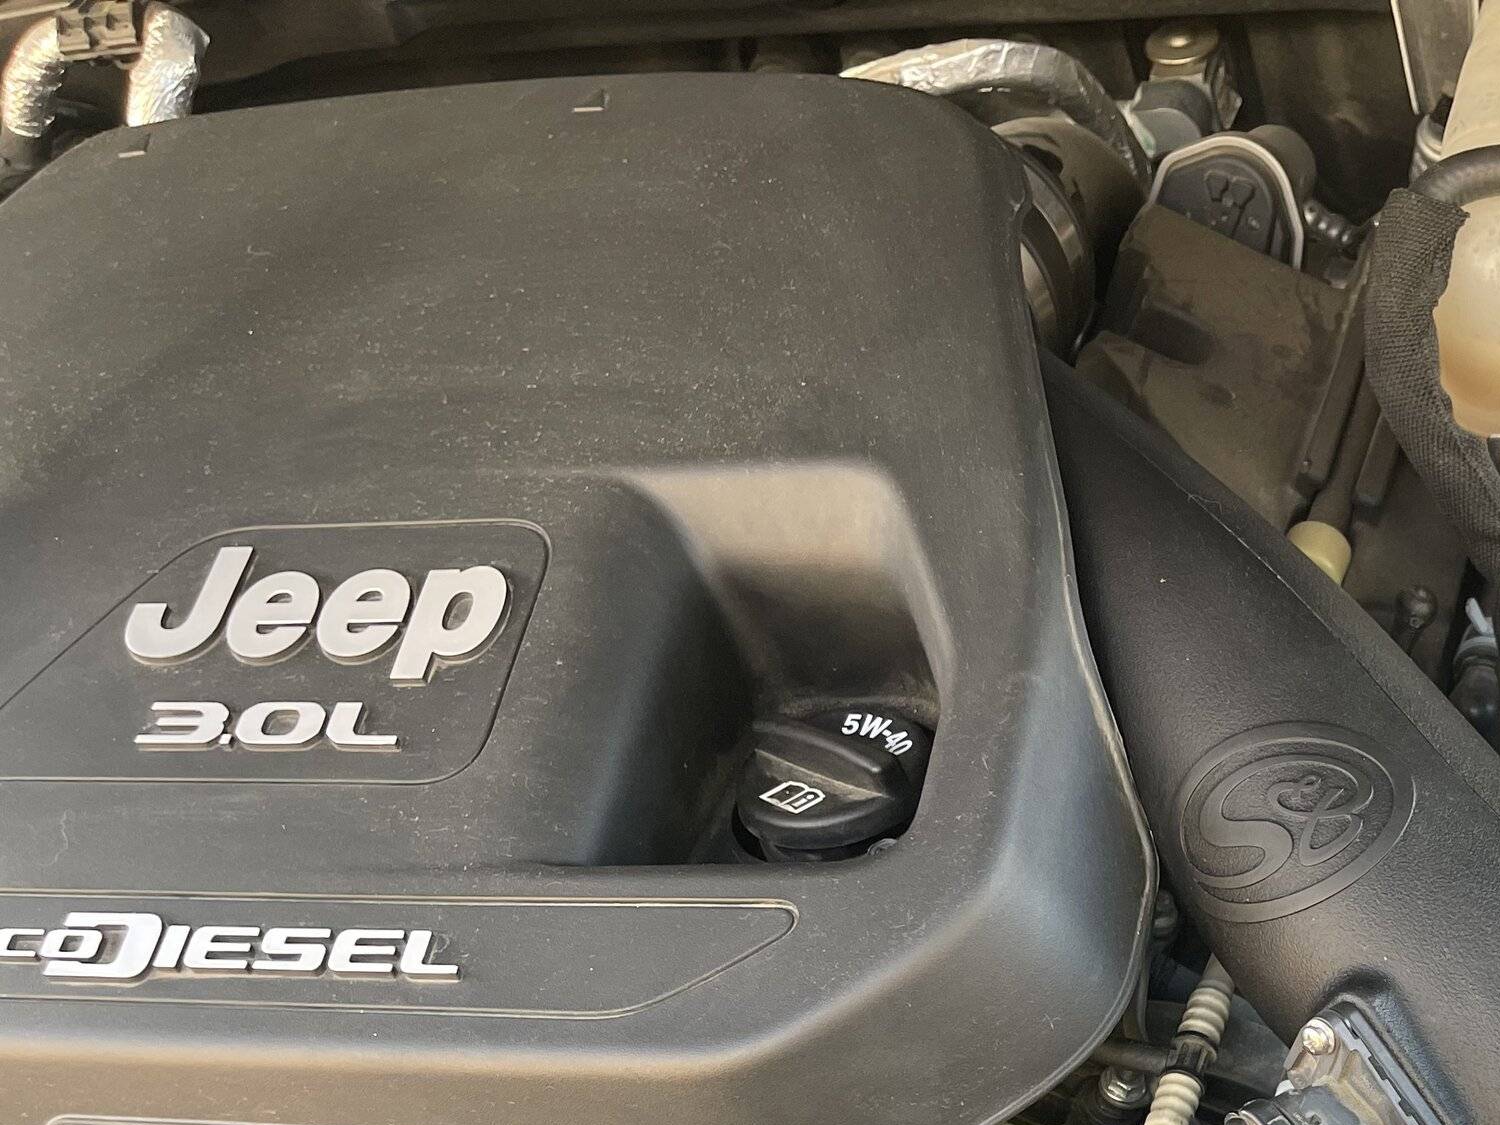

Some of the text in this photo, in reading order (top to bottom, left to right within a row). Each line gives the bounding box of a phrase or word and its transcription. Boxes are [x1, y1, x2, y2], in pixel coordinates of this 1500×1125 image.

[124, 547, 508, 683] Jeep
[135, 701, 399, 750] 3.0L
[841, 713, 913, 756] 5W-40
